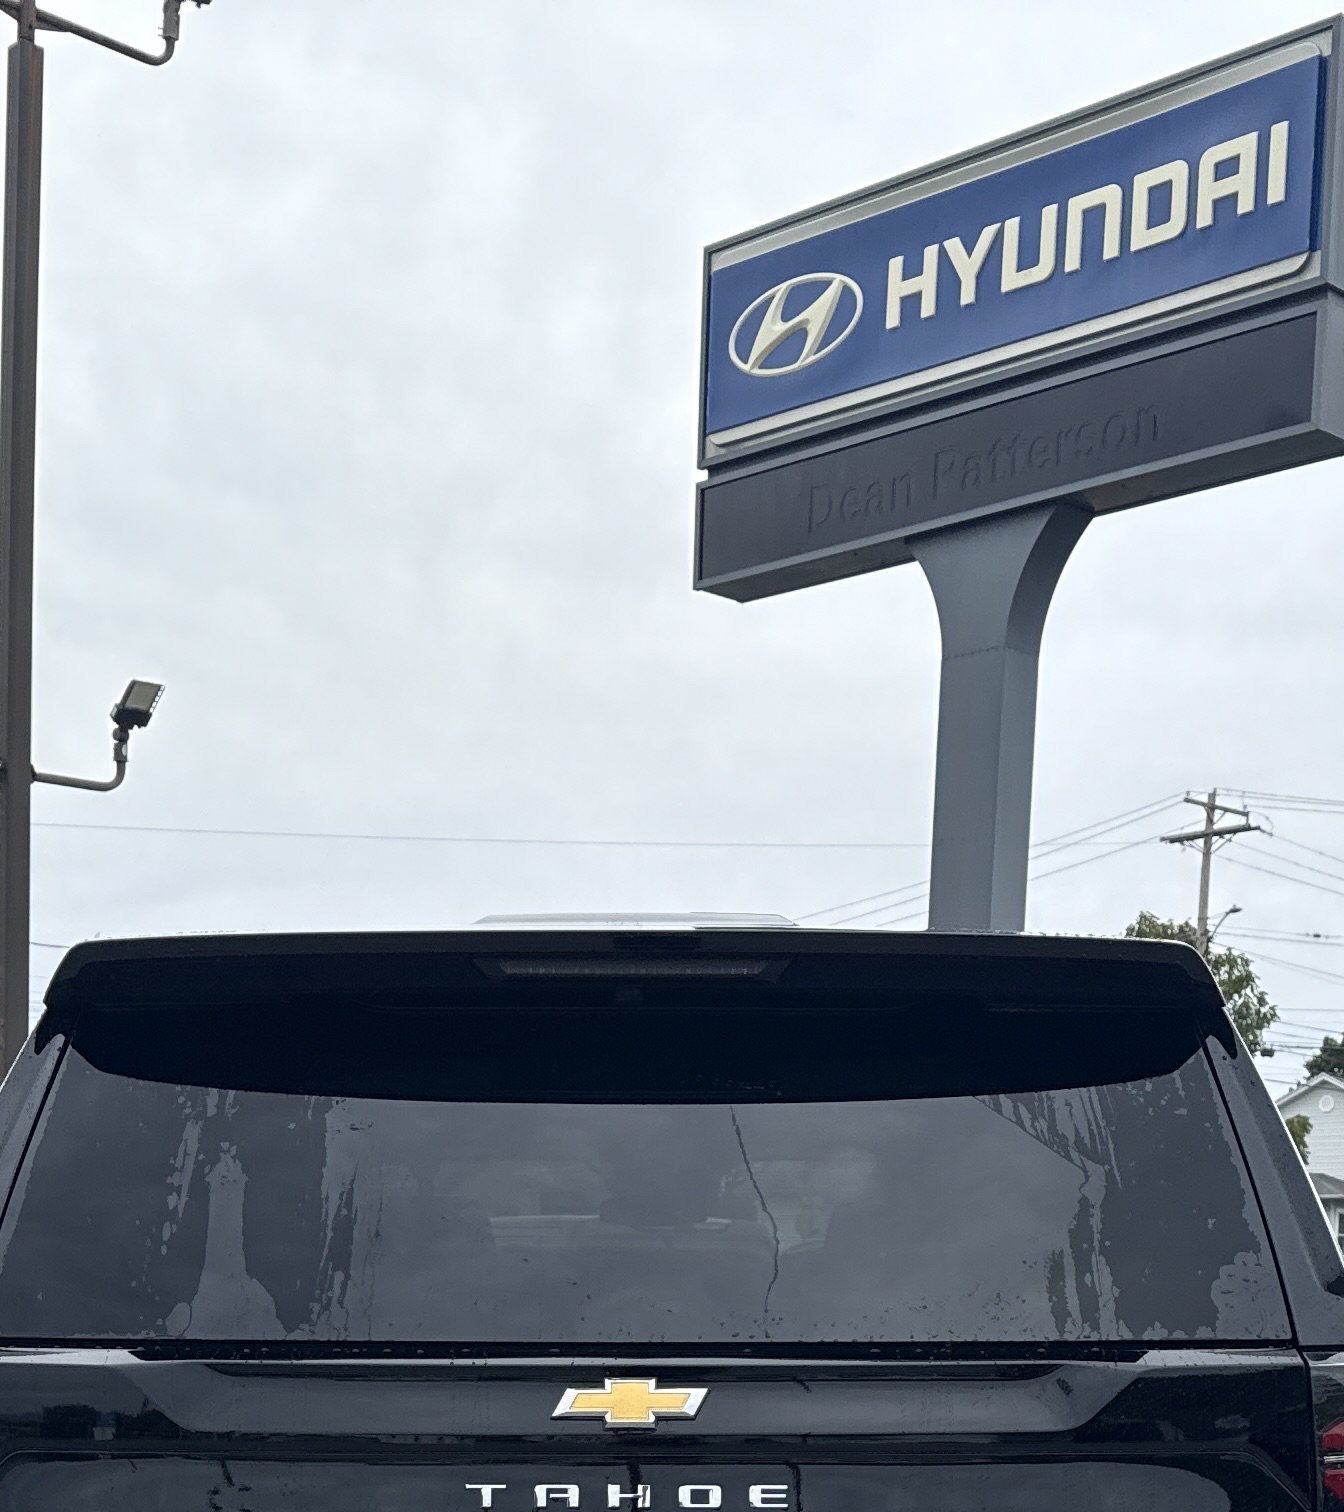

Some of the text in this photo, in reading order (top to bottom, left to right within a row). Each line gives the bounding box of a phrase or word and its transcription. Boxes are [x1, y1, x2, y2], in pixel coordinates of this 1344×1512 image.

[884, 120, 1290, 331] HYUNDAI
[808, 403, 1160, 533] Dean Patterson
[465, 1484, 788, 1509] TAHOE
